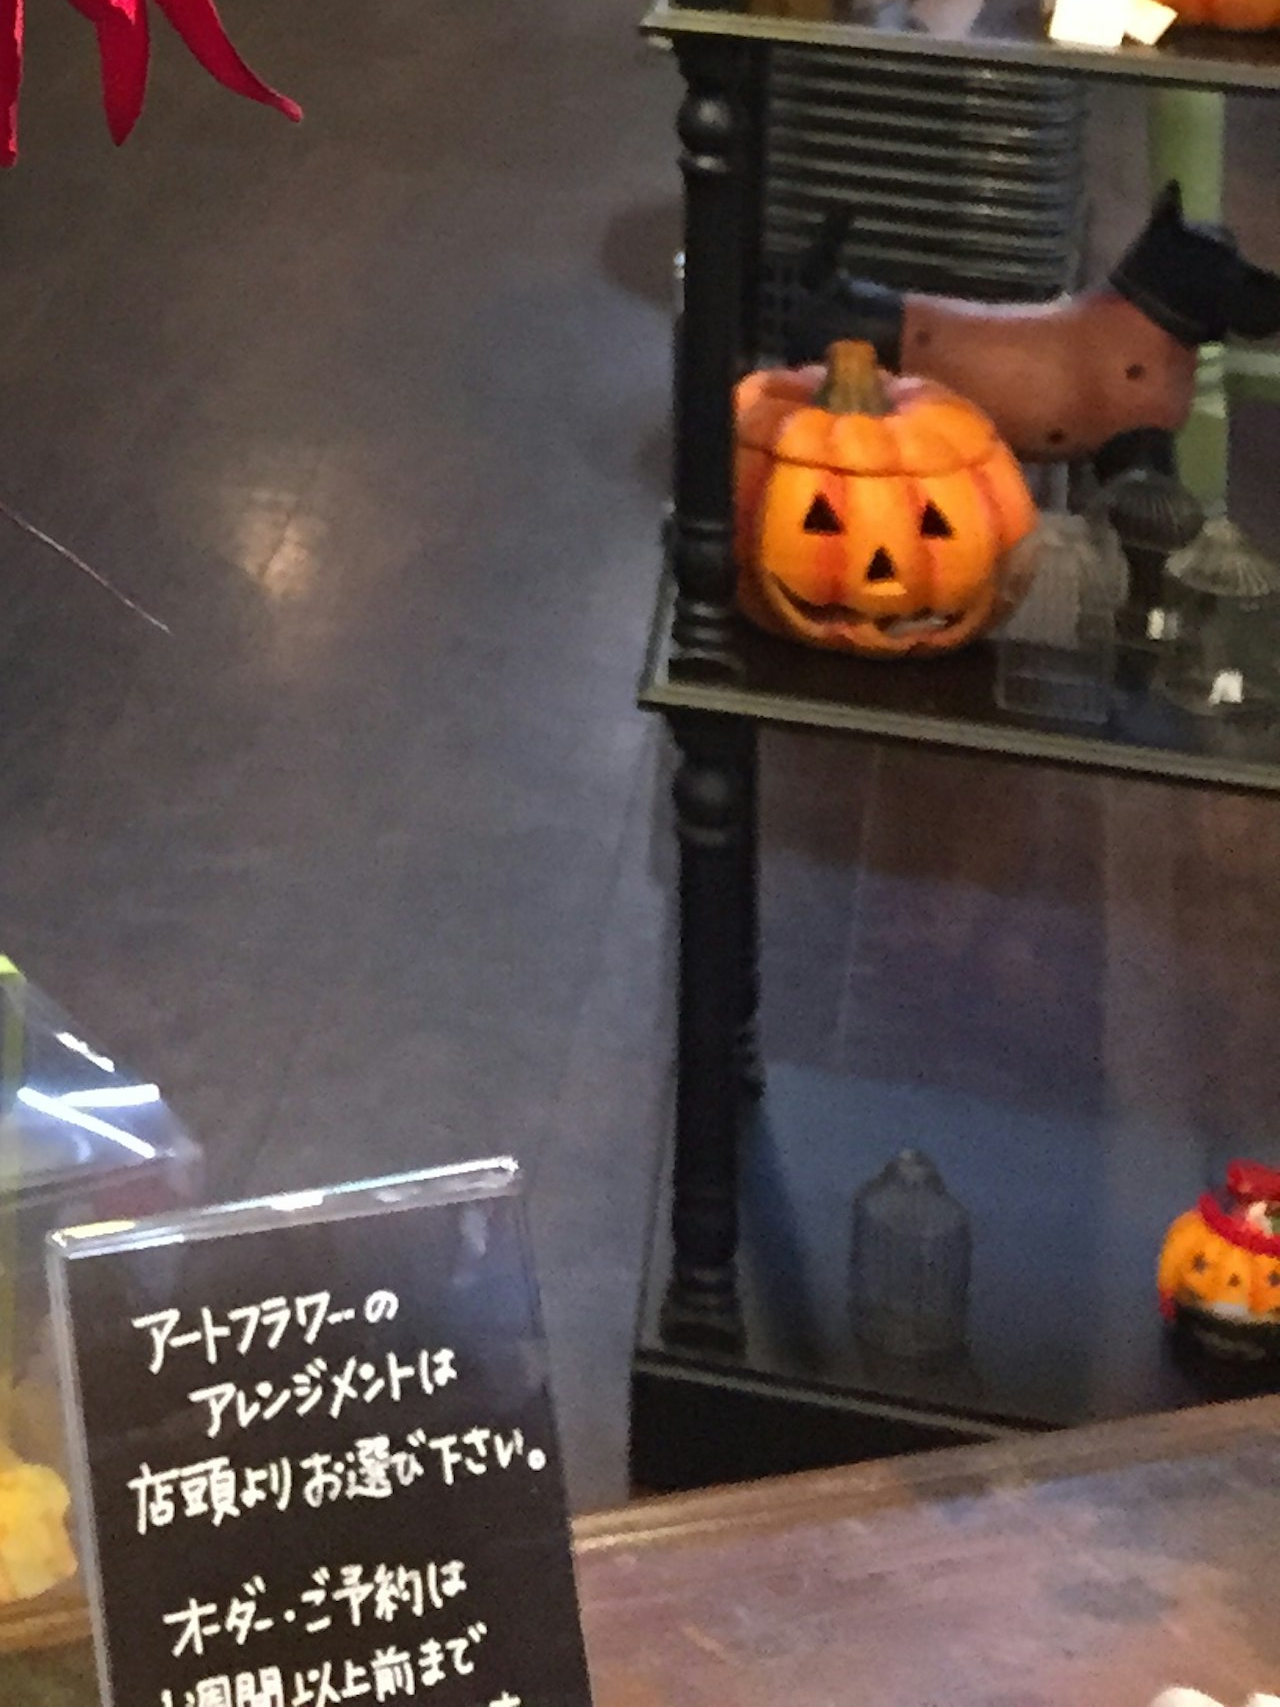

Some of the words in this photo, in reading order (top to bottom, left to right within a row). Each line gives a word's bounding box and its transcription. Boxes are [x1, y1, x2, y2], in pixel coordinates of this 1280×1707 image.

[131, 1288, 399, 1375] アートフラワーの
[188, 1349, 458, 1439] アレンジメントは
